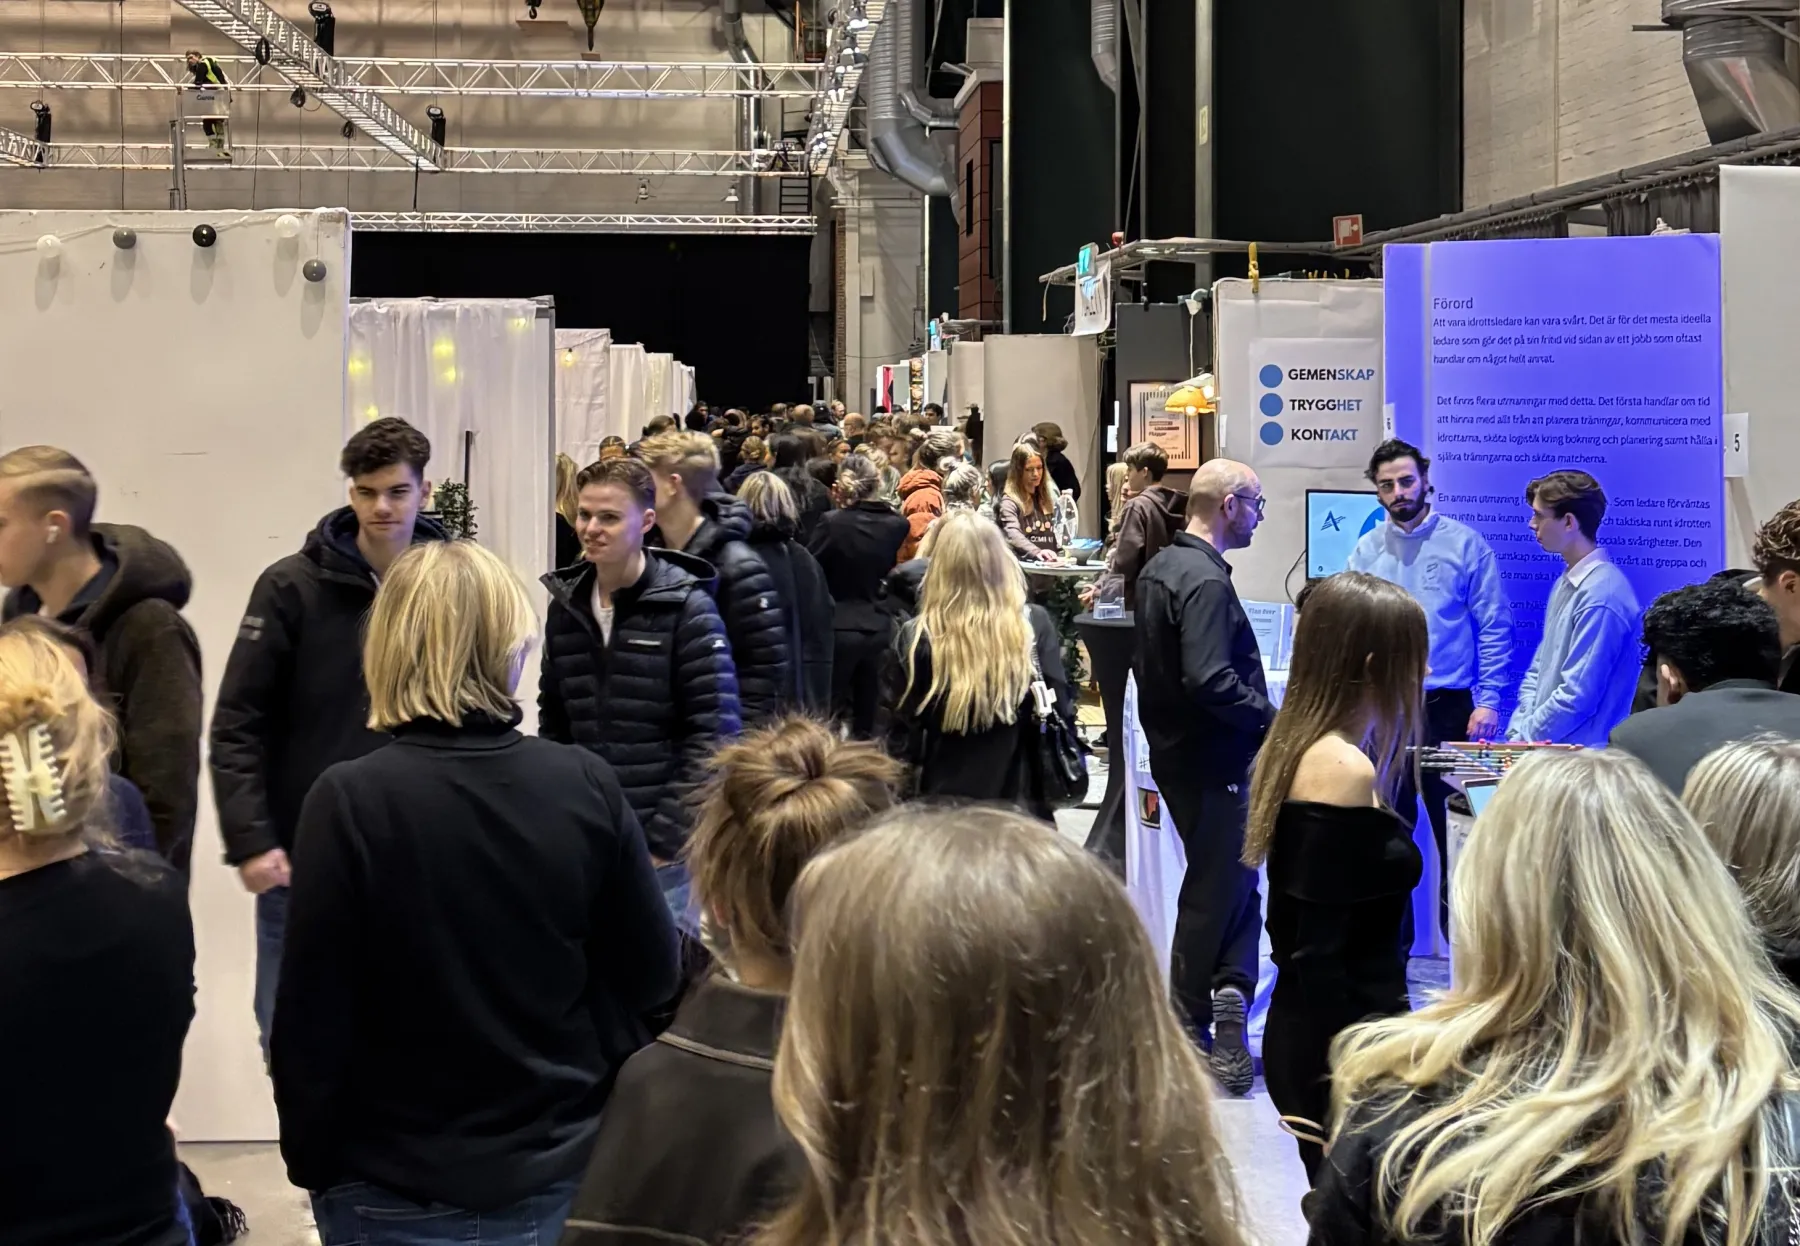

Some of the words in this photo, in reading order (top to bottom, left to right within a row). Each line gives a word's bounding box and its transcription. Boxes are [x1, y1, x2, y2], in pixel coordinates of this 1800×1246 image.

[1433, 297, 1473, 309] Förord
[1433, 318, 1445, 327] Att
[1447, 319, 1466, 327] vara
[1468, 317, 1522, 327] idrottsledare
[1524, 316, 1540, 326] kan
[1542, 317, 1560, 326] vara
[1562, 315, 1587, 325] svårt.
[1589, 315, 1604, 325] Det
[1607, 315, 1616, 325] är
[1618, 315, 1630, 325] för
[1633, 314, 1648, 324] det
[1650, 315, 1679, 324] mesta
[1681, 313, 1711, 324] ideella
[1433, 336, 1459, 345] ledare
[1497, 336, 1512, 345] det
[1514, 335, 1525, 346] på
[1564, 334, 1577, 344] vid
[1578, 334, 1602, 344] sidan
[1604, 336, 1615, 344] av
[1617, 335, 1629, 344] ett
[1631, 334, 1652, 346] jobb
[1653, 335, 1673, 343] som
[1676, 333, 1702, 343] oftast
[1433, 354, 1465, 364] handlar
[1467, 356, 1481, 364] om
[1483, 354, 1507, 366] något
[1288, 368, 1375, 381] GEMENSKAP
[1289, 399, 1363, 411] TRYGGHET
[1437, 396, 1451, 405] Det
[1476, 396, 1495, 405] flera
[1548, 396, 1568, 405] med
[1570, 396, 1595, 406] detta.
[1598, 396, 1613, 406] Det
[1616, 396, 1642, 406] första
[1644, 396, 1678, 406] handlar
[1681, 398, 1695, 406] om
[1698, 396, 1710, 406] tid
[1437, 415, 1448, 424] att
[1451, 414, 1474, 424] hinna
[1476, 415, 1495, 424] med
[1513, 414, 1530, 424] från
[1545, 415, 1579, 426] planera
[1625, 416, 1688, 426] kommunicera
[1690, 416, 1711, 426] med
[1291, 429, 1359, 441] KONTAKT
[1541, 434, 1564, 446] kring
[1565, 435, 1600, 446] bokning
[1602, 435, 1619, 445] och
[1621, 435, 1663, 447] planering
[1665, 437, 1688, 446] samt
[1690, 435, 1712, 446] hålla
[1734, 433, 1741, 453] 5
[1514, 453, 1530, 462] och
[1557, 453, 1607, 464] matcherna.
[1438, 493, 1449, 502] En
[1451, 495, 1477, 504] annan
[1479, 496, 1520, 506] utmaning
[1614, 497, 1634, 507] Som
[1636, 498, 1665, 508] ledare
[1667, 498, 1710, 509] förväntas
[1477, 513, 1496, 522] bara
[1498, 514, 1525, 522] kunna
[1616, 518, 1651, 527] taktiska
[1653, 519, 1673, 528] runt
[1674, 519, 1711, 529] idrotten
[1628, 536, 1682, 548] svårigheter.
[1683, 538, 1702, 547] Den
[1532, 554, 1550, 562] som
[1616, 555, 1639, 565] svårt
[1641, 556, 1654, 565] att
[1656, 558, 1688, 568] greppa
[1690, 557, 1707, 568] och
[1534, 572, 1549, 581] ska
